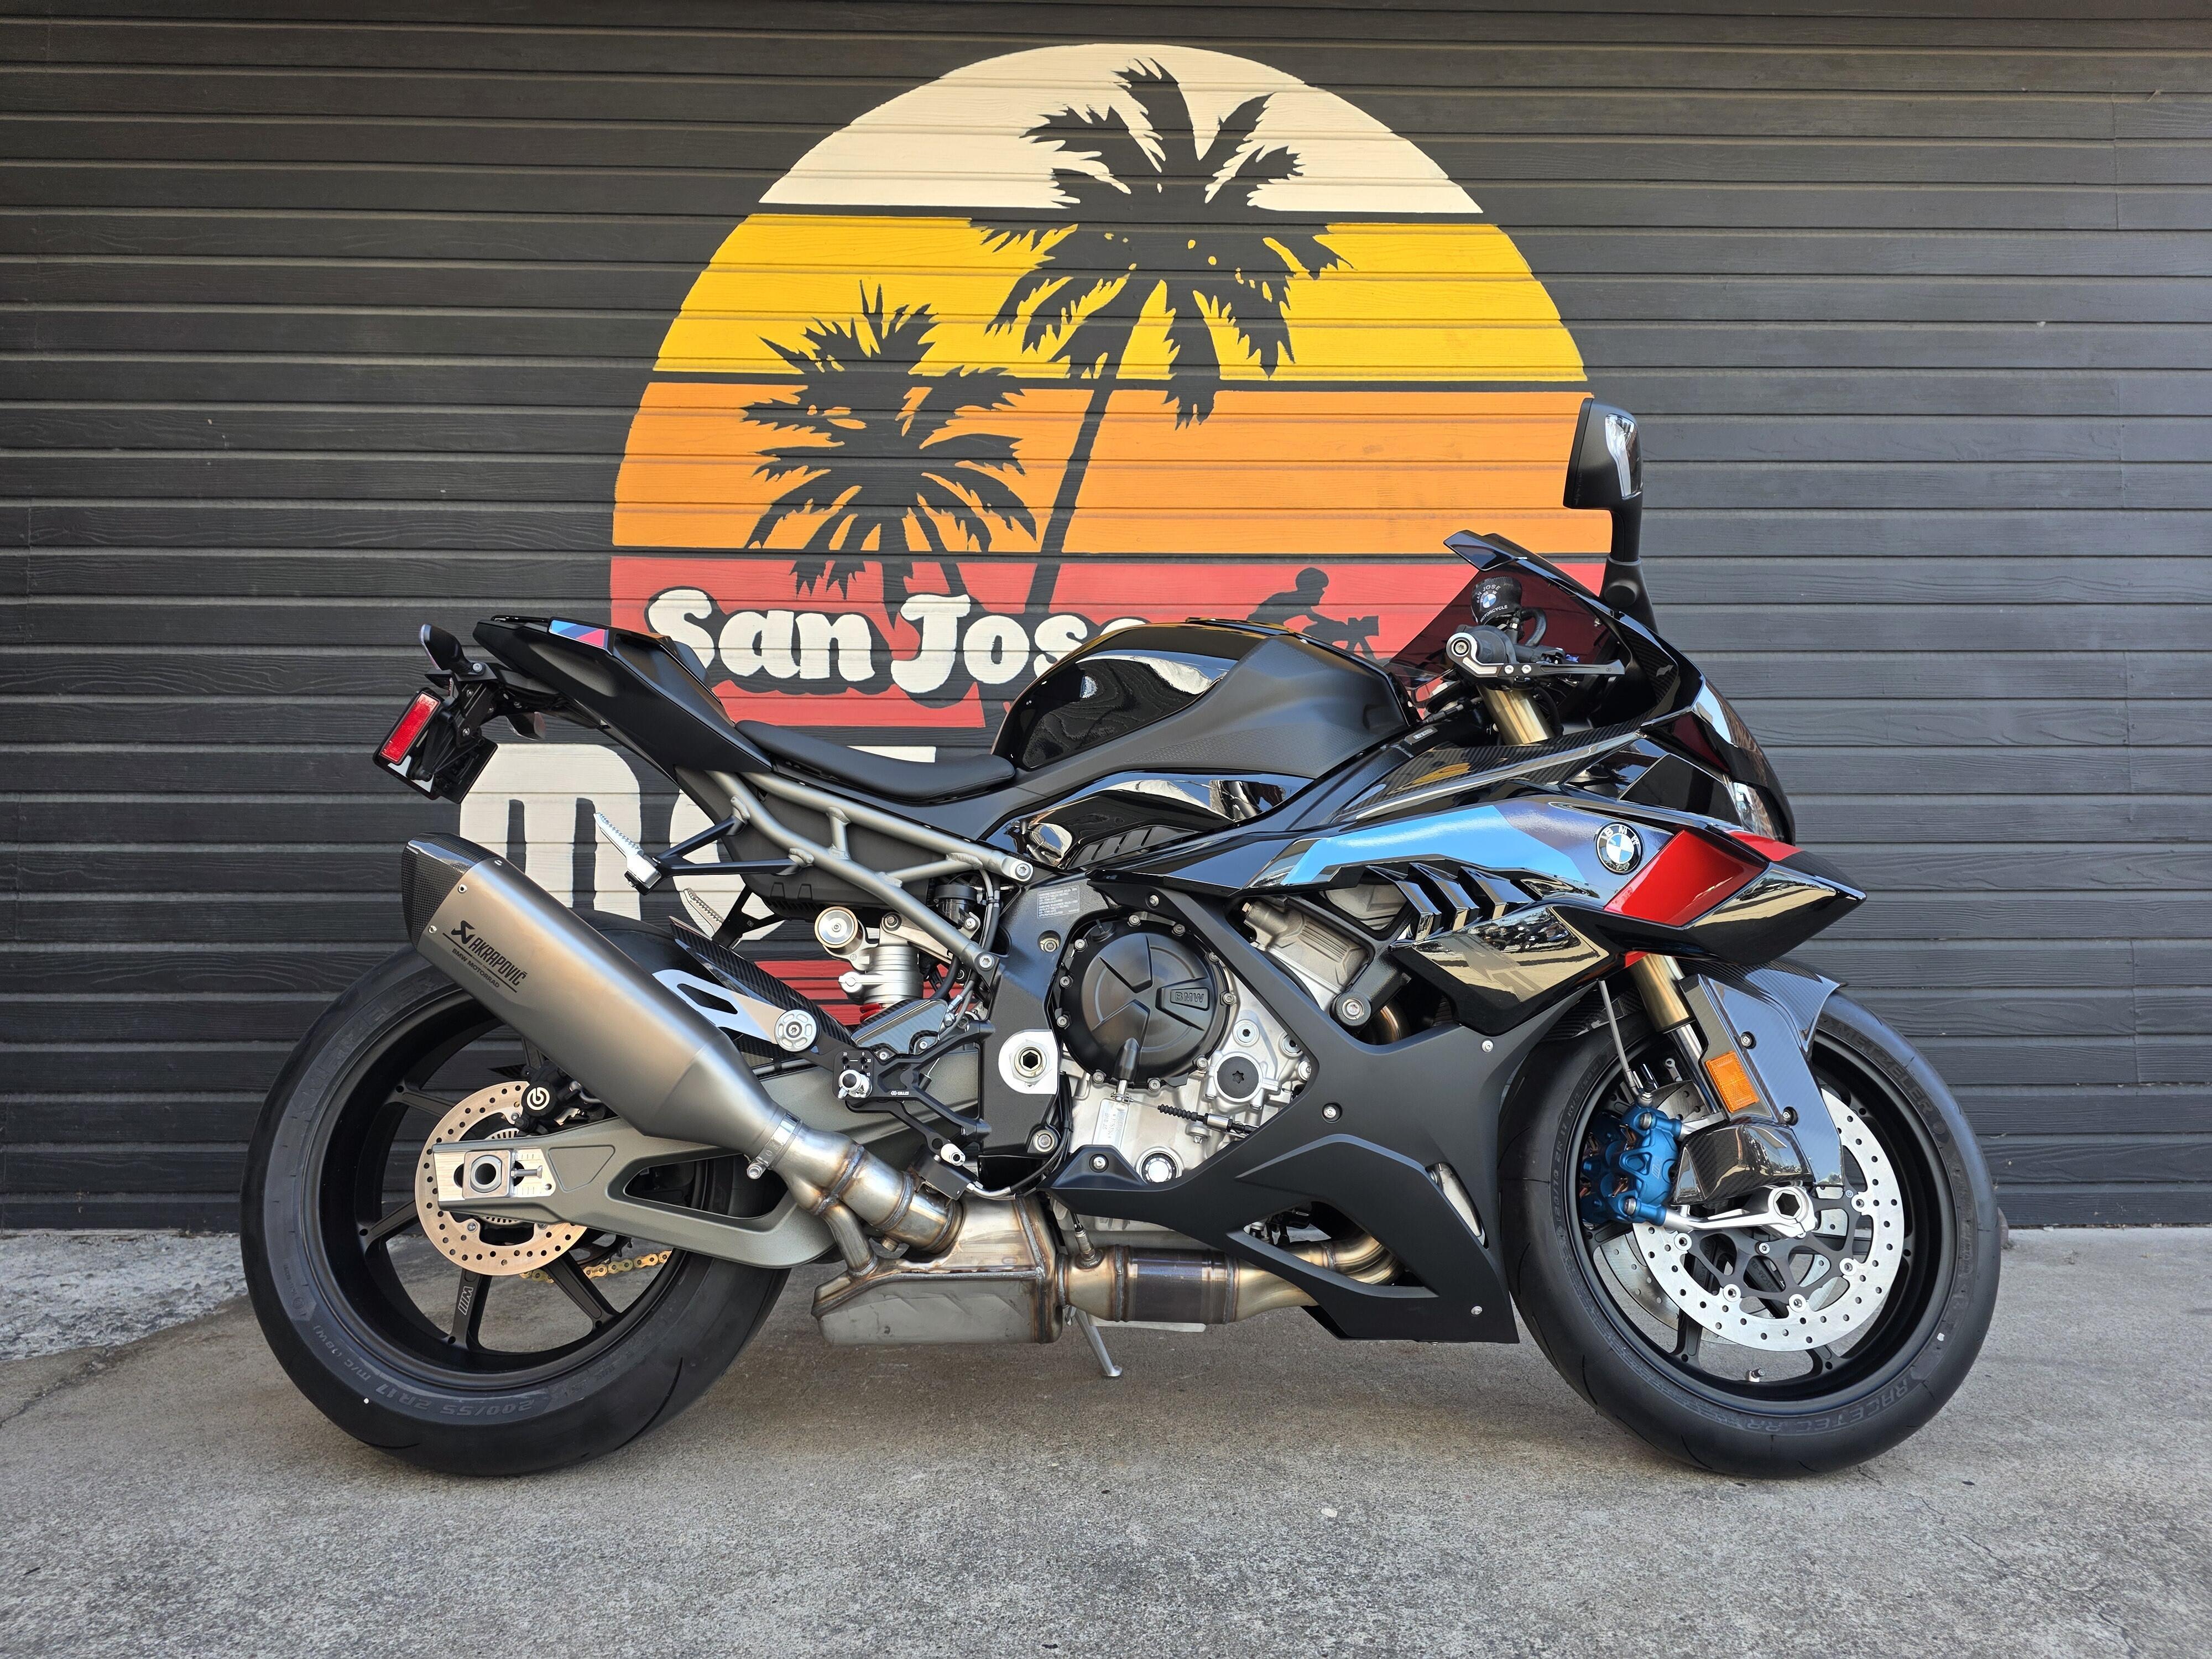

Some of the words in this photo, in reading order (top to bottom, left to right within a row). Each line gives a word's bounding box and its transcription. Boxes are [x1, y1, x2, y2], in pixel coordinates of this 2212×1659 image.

[648, 589, 875, 682] San
[890, 594, 1146, 693] Jos
[452, 948, 468, 962] BMW
[467, 960, 500, 988] MOTORRAD
[1175, 992, 1204, 1003] BMW
[375, 1383, 398, 1399] 17
[399, 1395, 432, 1410] ZR
[440, 1399, 535, 1416] 200/55
[1796, 1378, 1908, 1432] RACETEC
